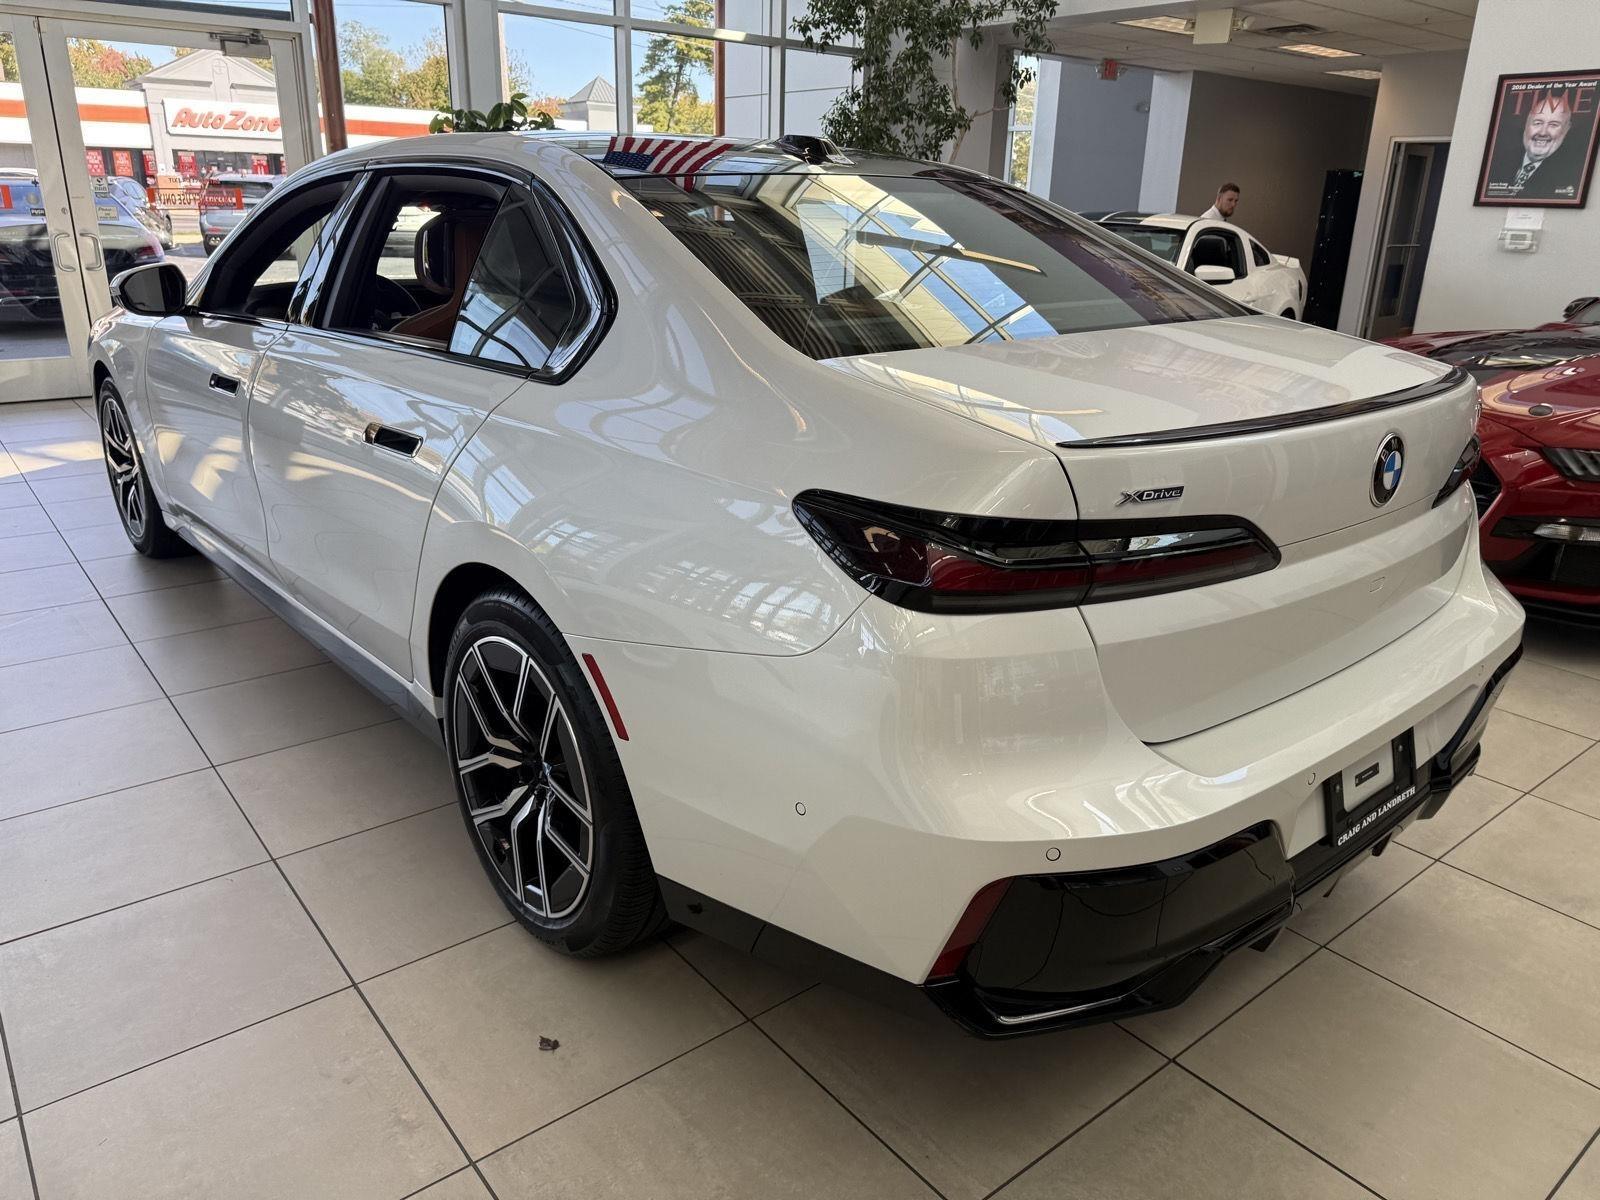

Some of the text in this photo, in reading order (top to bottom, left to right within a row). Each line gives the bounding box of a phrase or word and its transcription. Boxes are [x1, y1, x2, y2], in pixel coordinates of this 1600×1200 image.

[1510, 87, 1596, 115] TIME
[171, 107, 281, 132] AutoZone
[1338, 786, 1416, 846] CRAIG AND LANDRETH
